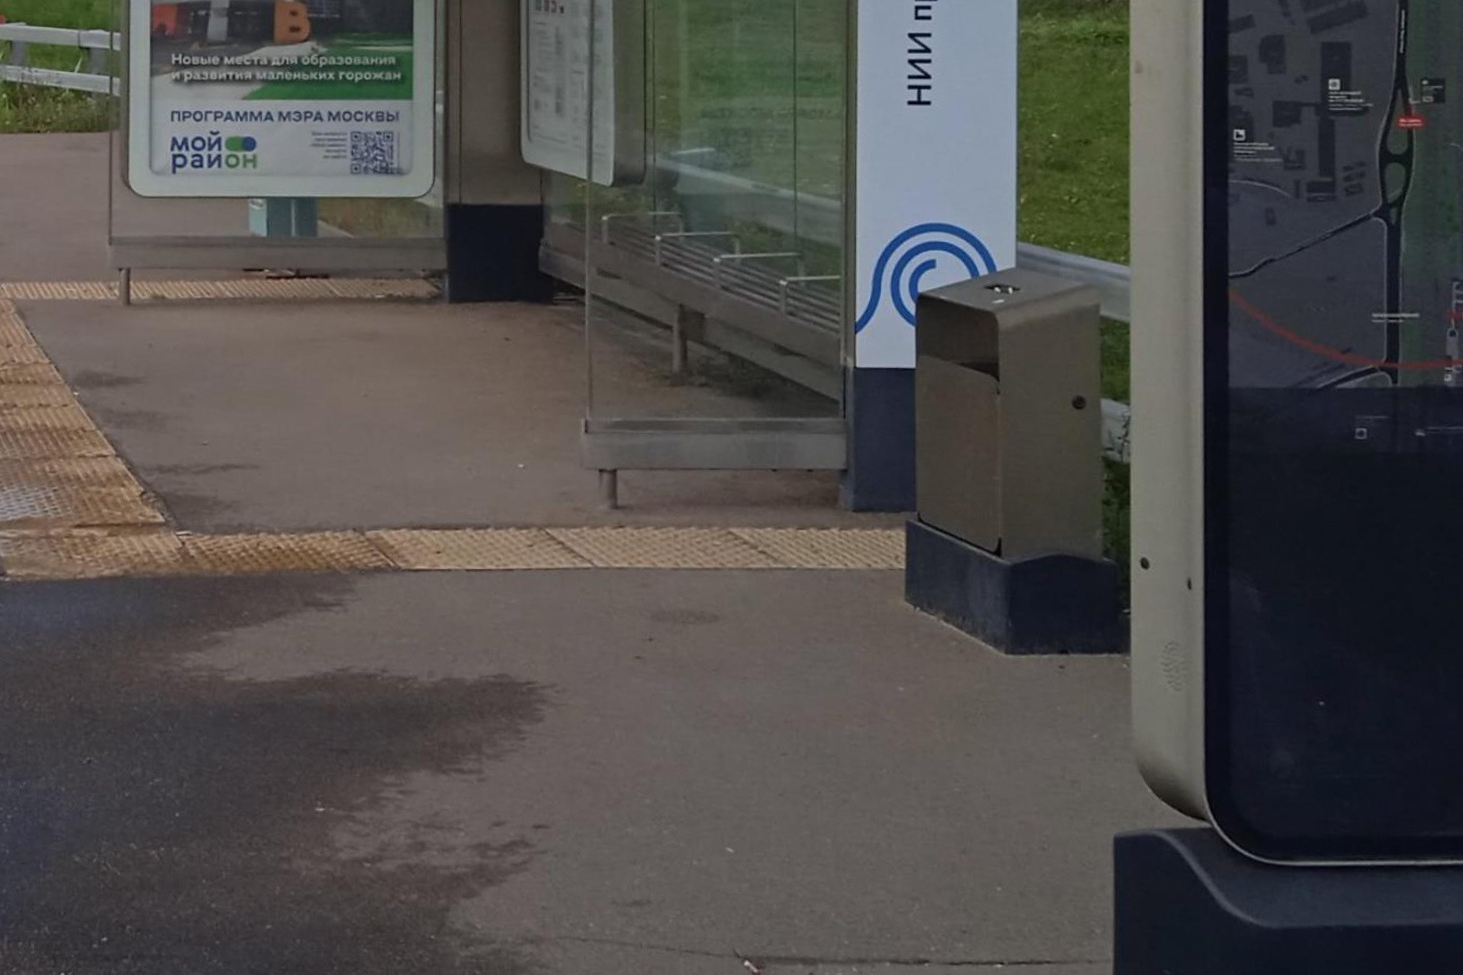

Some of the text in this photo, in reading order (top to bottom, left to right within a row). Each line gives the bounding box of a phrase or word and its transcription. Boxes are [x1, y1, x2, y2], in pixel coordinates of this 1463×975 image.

[171, 54, 396, 67] Новые места для образования
[907, 32, 933, 107] НИИ
[183, 71, 252, 82] развития
[256, 71, 336, 80] маленьких
[338, 71, 401, 82] горожан
[170, 110, 400, 123] ПРОГРАММА МЭРА МОСКВЫ
[170, 131, 222, 151] мой
